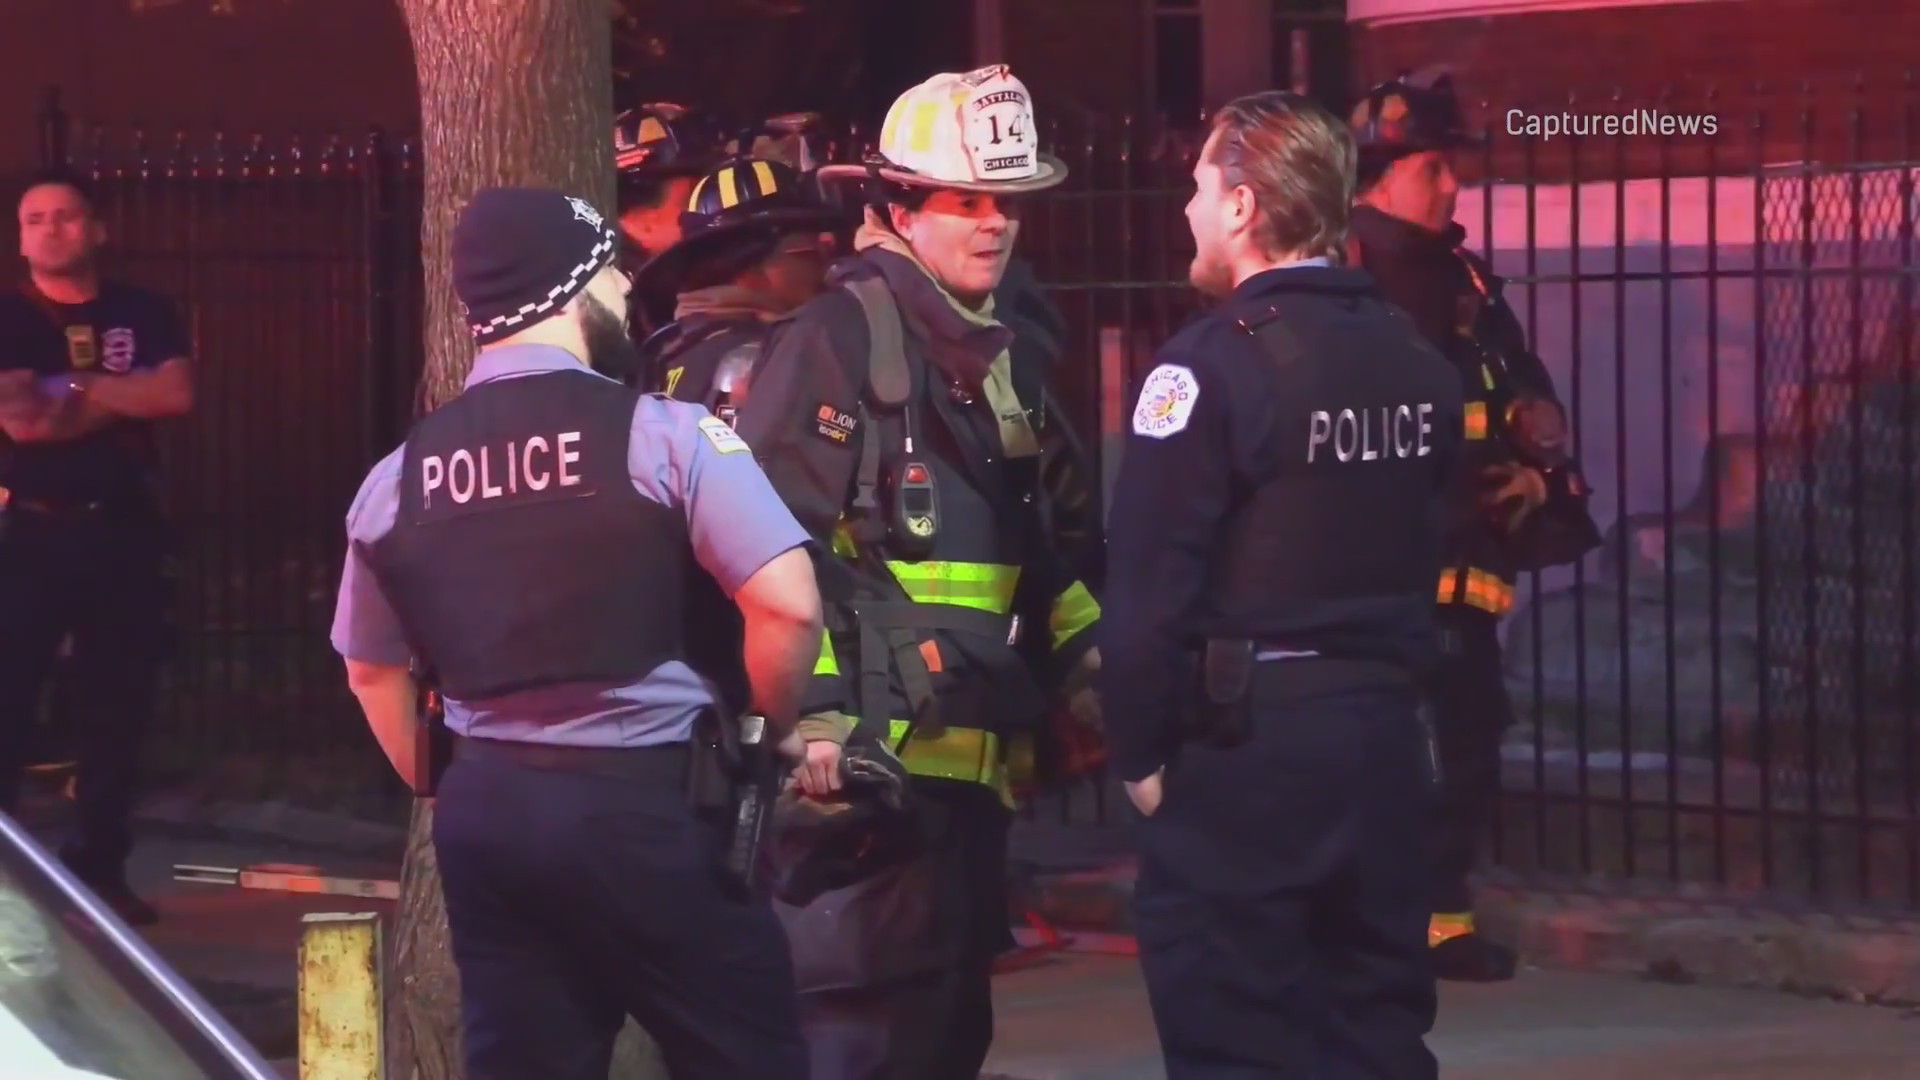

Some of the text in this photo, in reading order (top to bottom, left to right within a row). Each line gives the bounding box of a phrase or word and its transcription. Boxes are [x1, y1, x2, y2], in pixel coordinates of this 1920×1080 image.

[988, 115, 1024, 145] 14
[984, 157, 1028, 169] CHICAGO
[830, 410, 857, 430] LION
[1307, 403, 1433, 463] POLICE
[422, 431, 582, 510] POLICE
